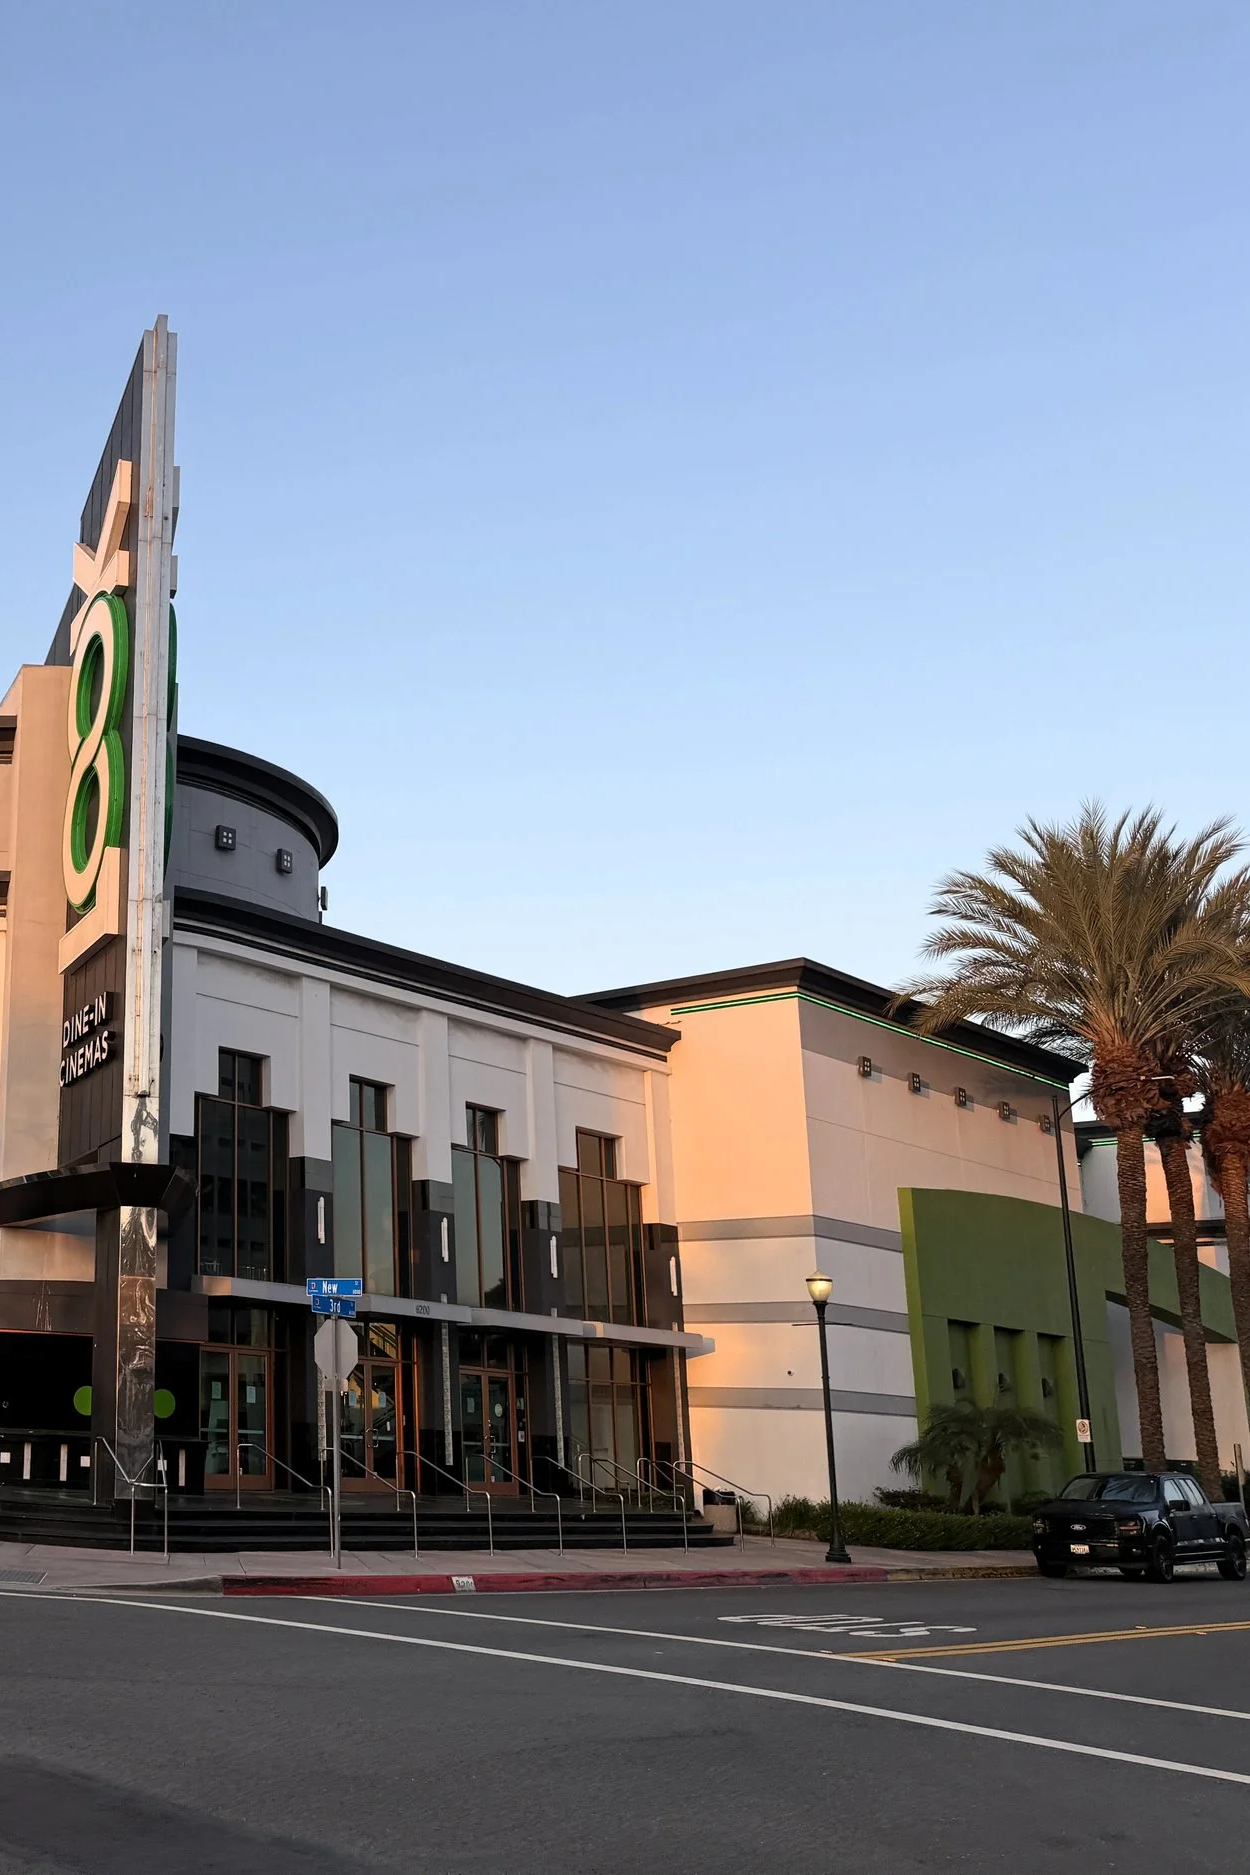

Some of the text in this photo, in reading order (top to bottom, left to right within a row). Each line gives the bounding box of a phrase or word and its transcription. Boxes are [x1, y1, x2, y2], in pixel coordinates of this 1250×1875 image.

[62, 991, 107, 1048] DINE-IN
[59, 1030, 109, 1087] CINEMAS
[322, 1280, 338, 1294] New
[329, 1298, 341, 1313] 3rd
